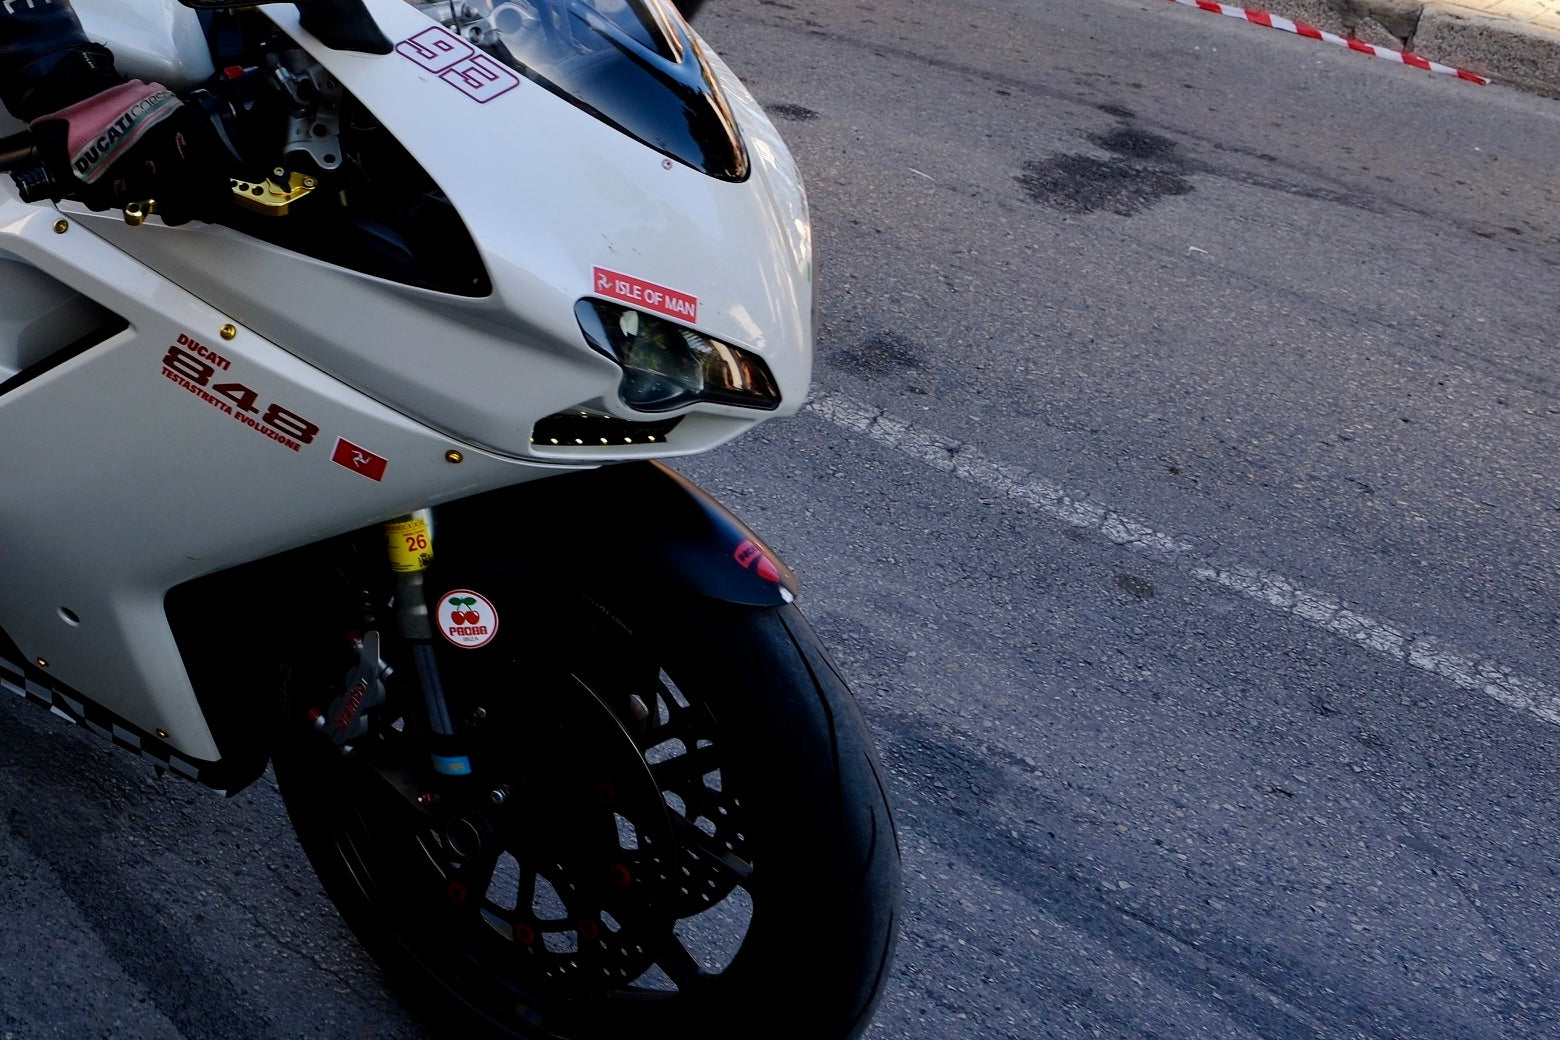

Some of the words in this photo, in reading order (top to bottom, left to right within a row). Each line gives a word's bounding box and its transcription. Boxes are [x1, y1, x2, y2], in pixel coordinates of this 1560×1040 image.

[395, 26, 520, 103] 93
[615, 280, 642, 300] ISLE
[644, 289, 663, 306] OF
[665, 295, 695, 317] MAN
[176, 333, 232, 371] DUCATI
[161, 366, 233, 415] TESTASTRETTA
[234, 412, 302, 452] EVOLUZIONE
[162, 345, 320, 445] 848
[406, 534, 427, 552] 26
